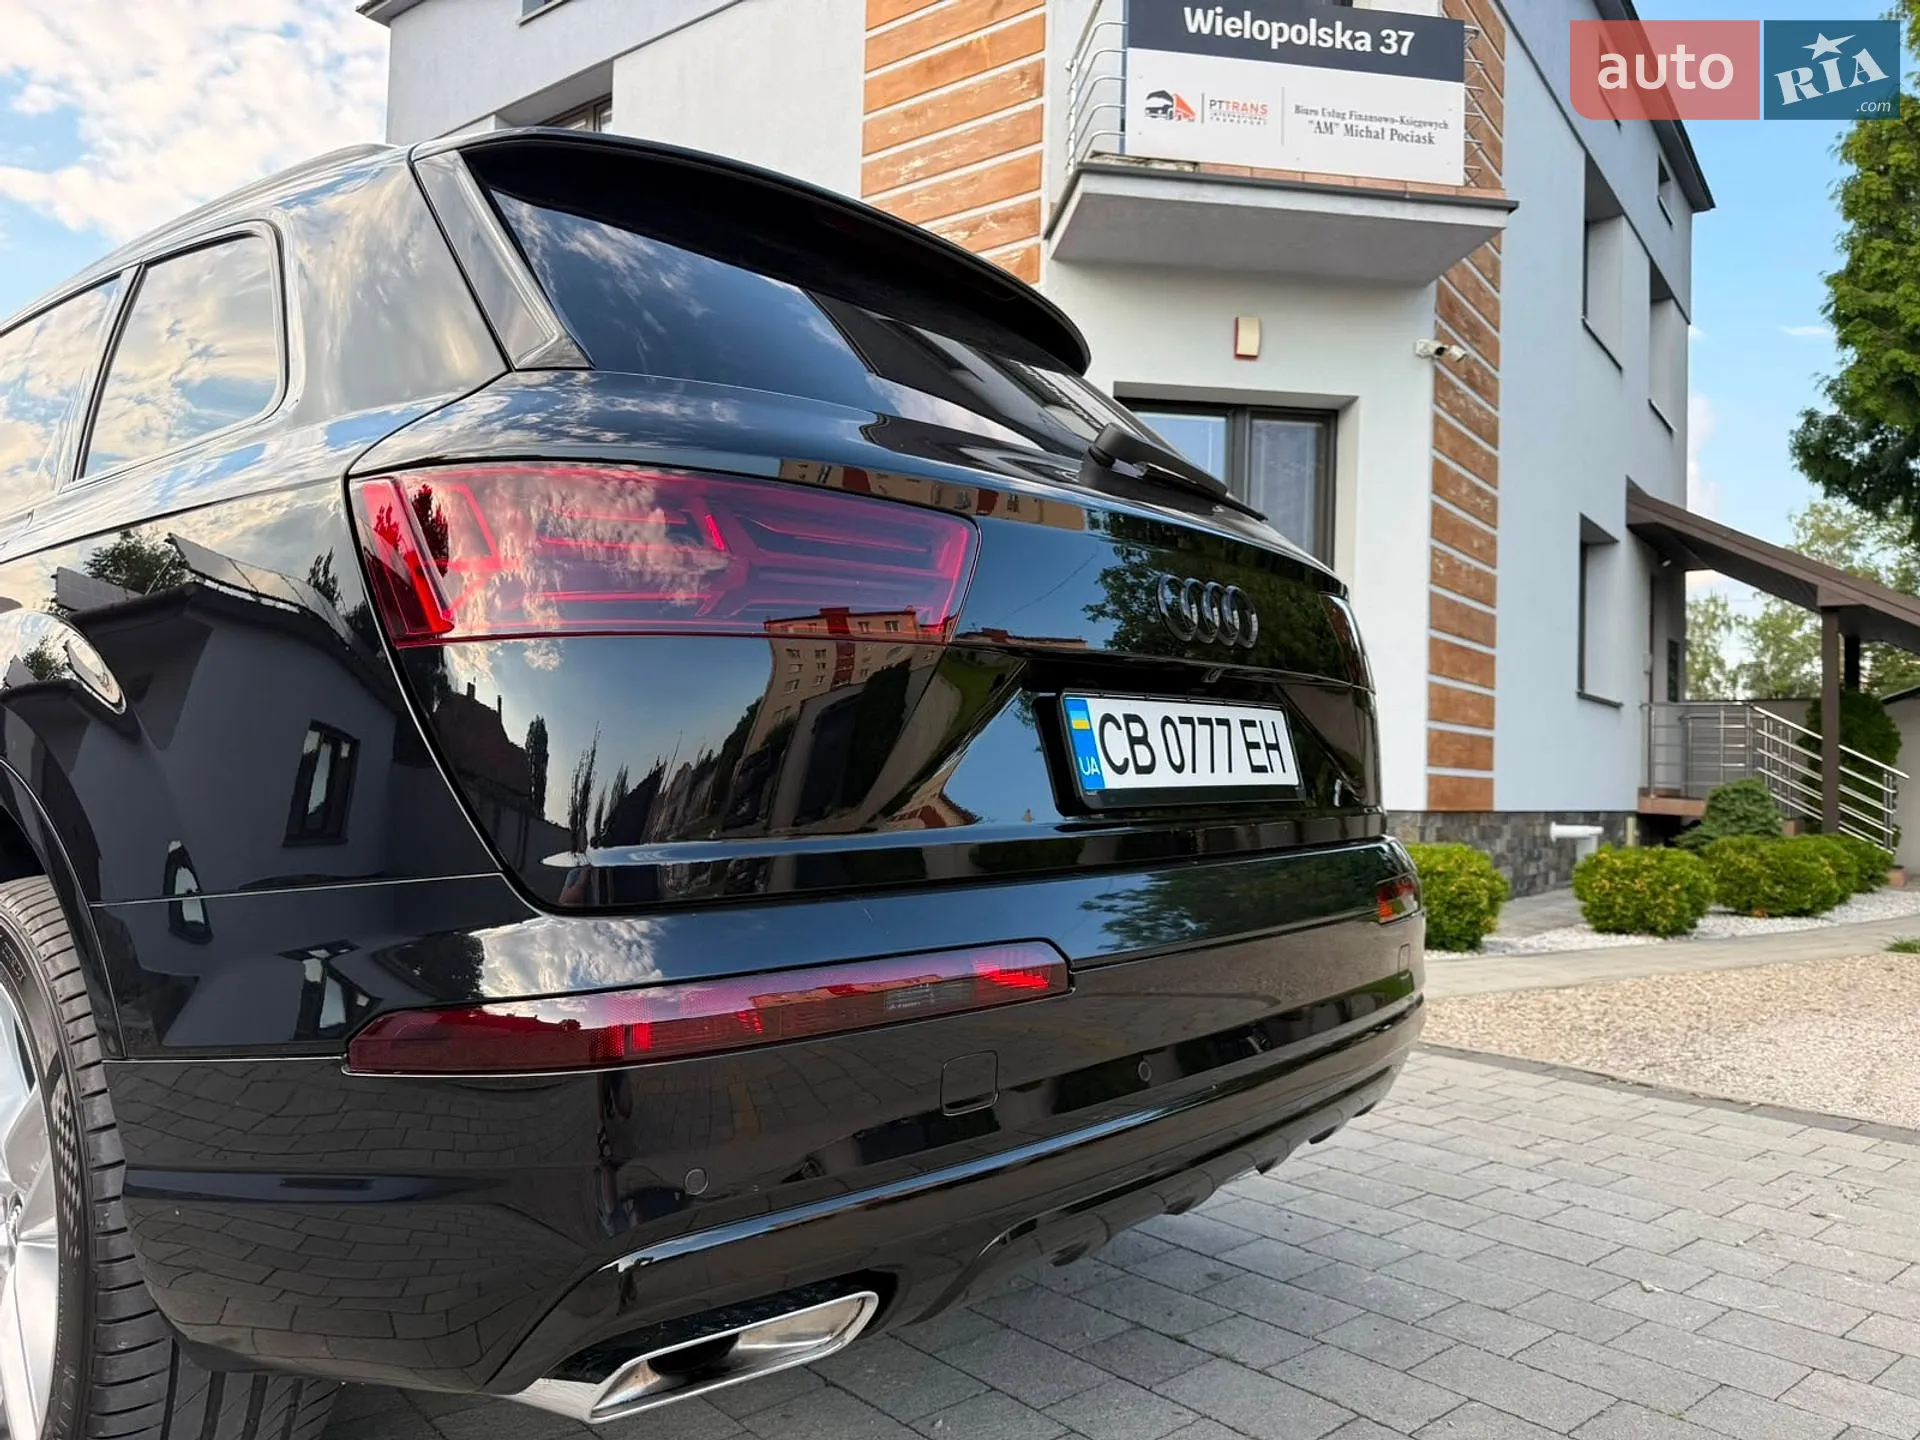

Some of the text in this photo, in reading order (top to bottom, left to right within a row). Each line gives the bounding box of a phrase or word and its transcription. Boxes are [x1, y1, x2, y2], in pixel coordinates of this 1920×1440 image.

[1184, 7, 1415, 56] Wielopolska 37
[1390, 128, 1436, 145] Pociask
[1099, 713, 1286, 775] CB 0777 EH
[1078, 756, 1100, 776] UA
